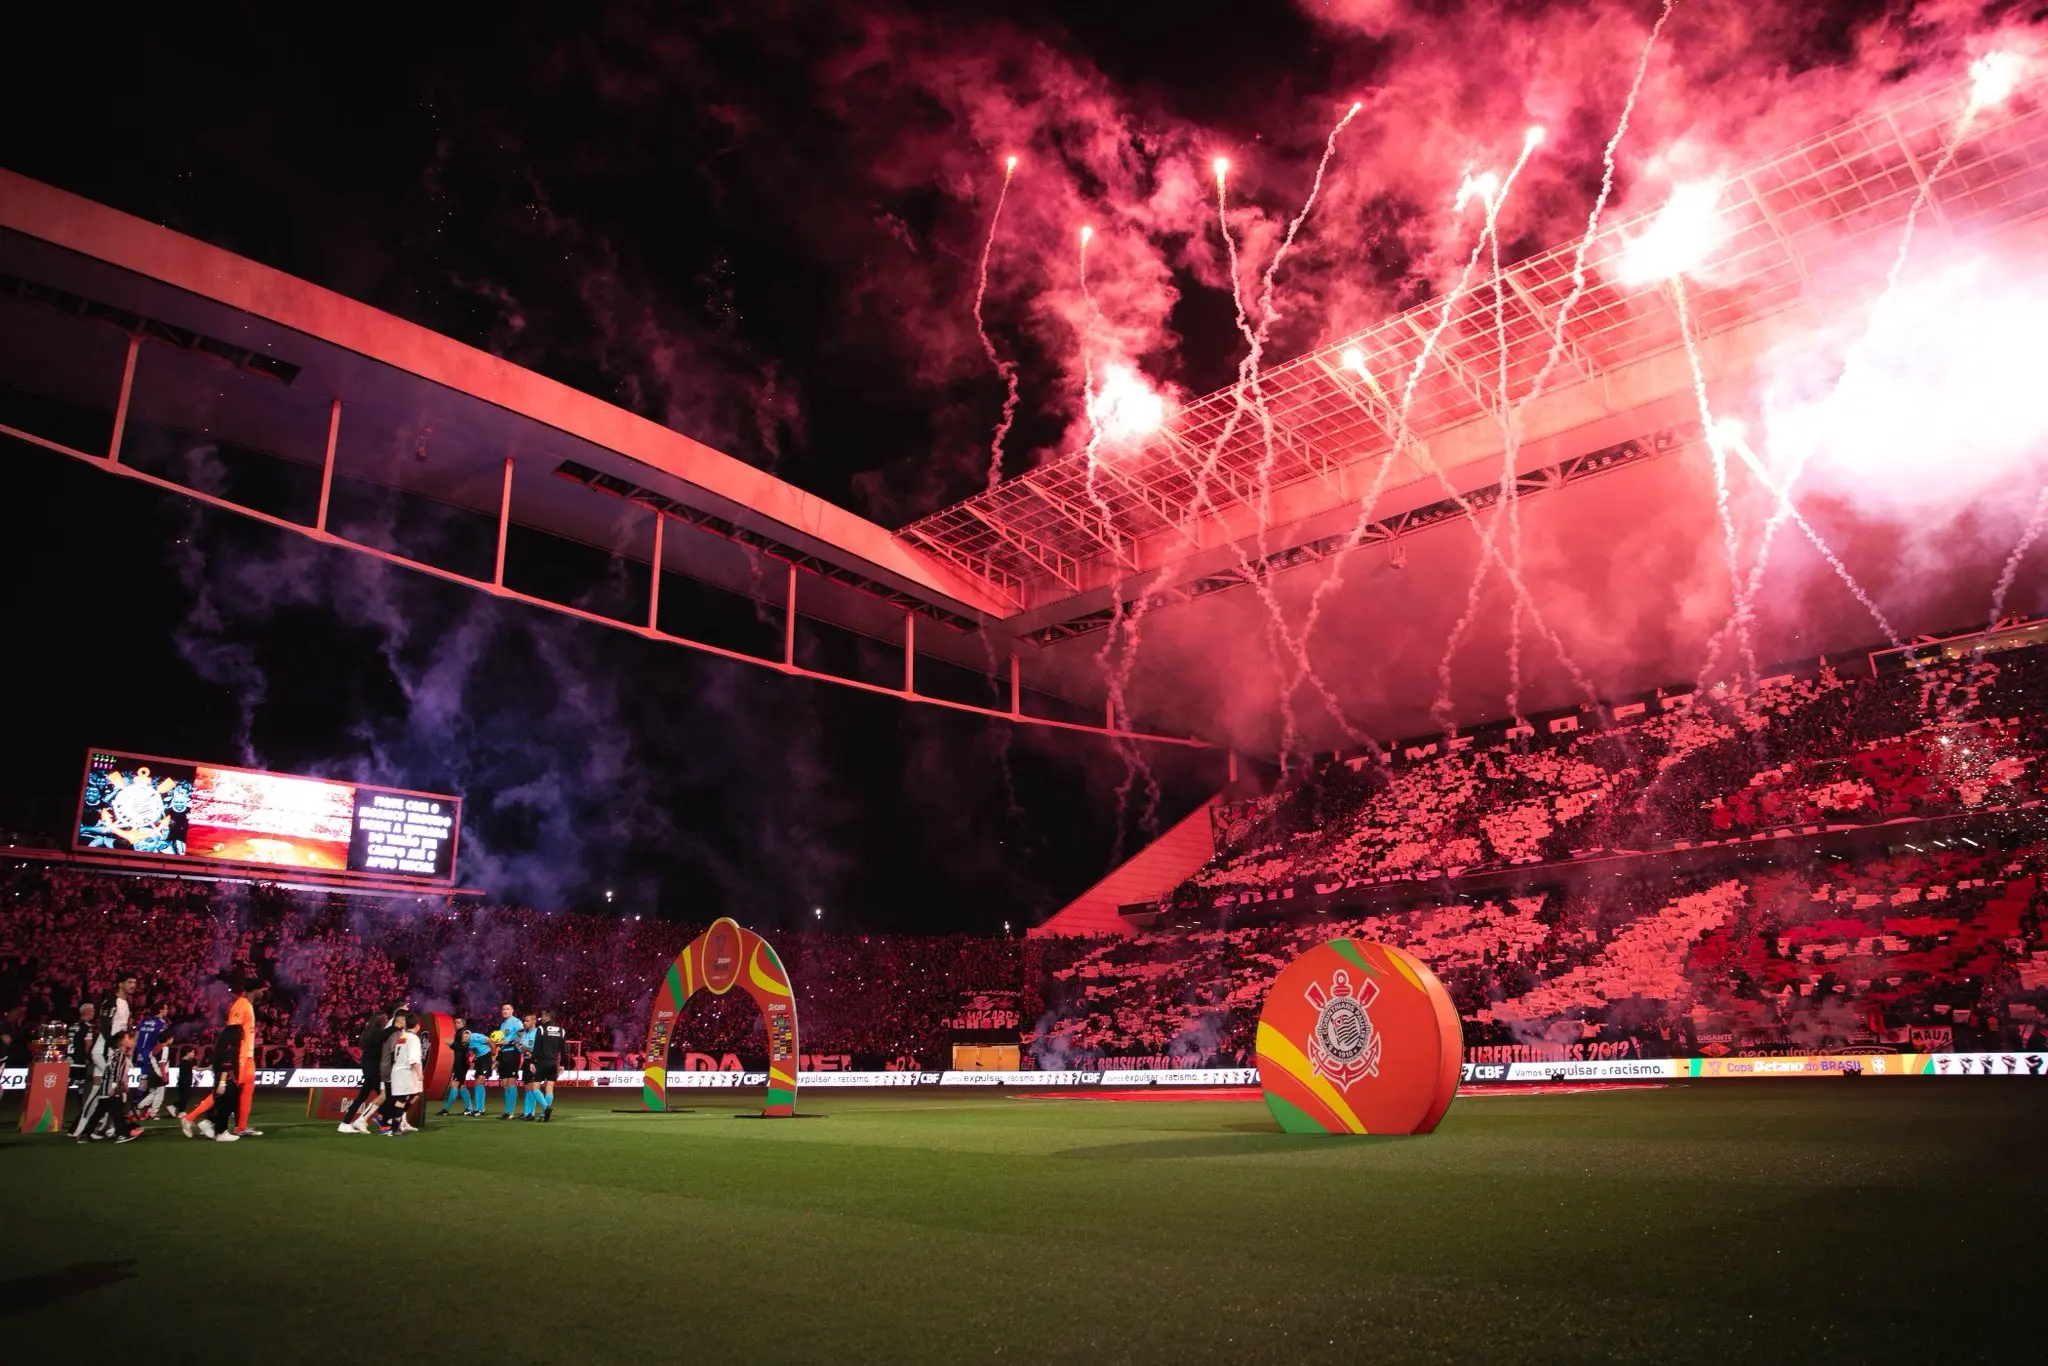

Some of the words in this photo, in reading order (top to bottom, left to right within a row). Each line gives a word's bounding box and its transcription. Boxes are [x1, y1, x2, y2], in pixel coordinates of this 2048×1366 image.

[1338, 1050, 1354, 1059] 1910
[1821, 1060, 1865, 1072] BRASIL
[1081, 1072, 1100, 1083] CBF
[1124, 1072, 1159, 1083] expulsar
[1475, 1066, 1504, 1079] CBF
[1515, 1069, 1543, 1077] Vamos
[1544, 1065, 1598, 1080] expulsar
[1609, 1065, 1664, 1075] racismo.
[589, 1074, 633, 1085] exulsar
[743, 1073, 767, 1085] CBF
[920, 1073, 940, 1084] CBF
